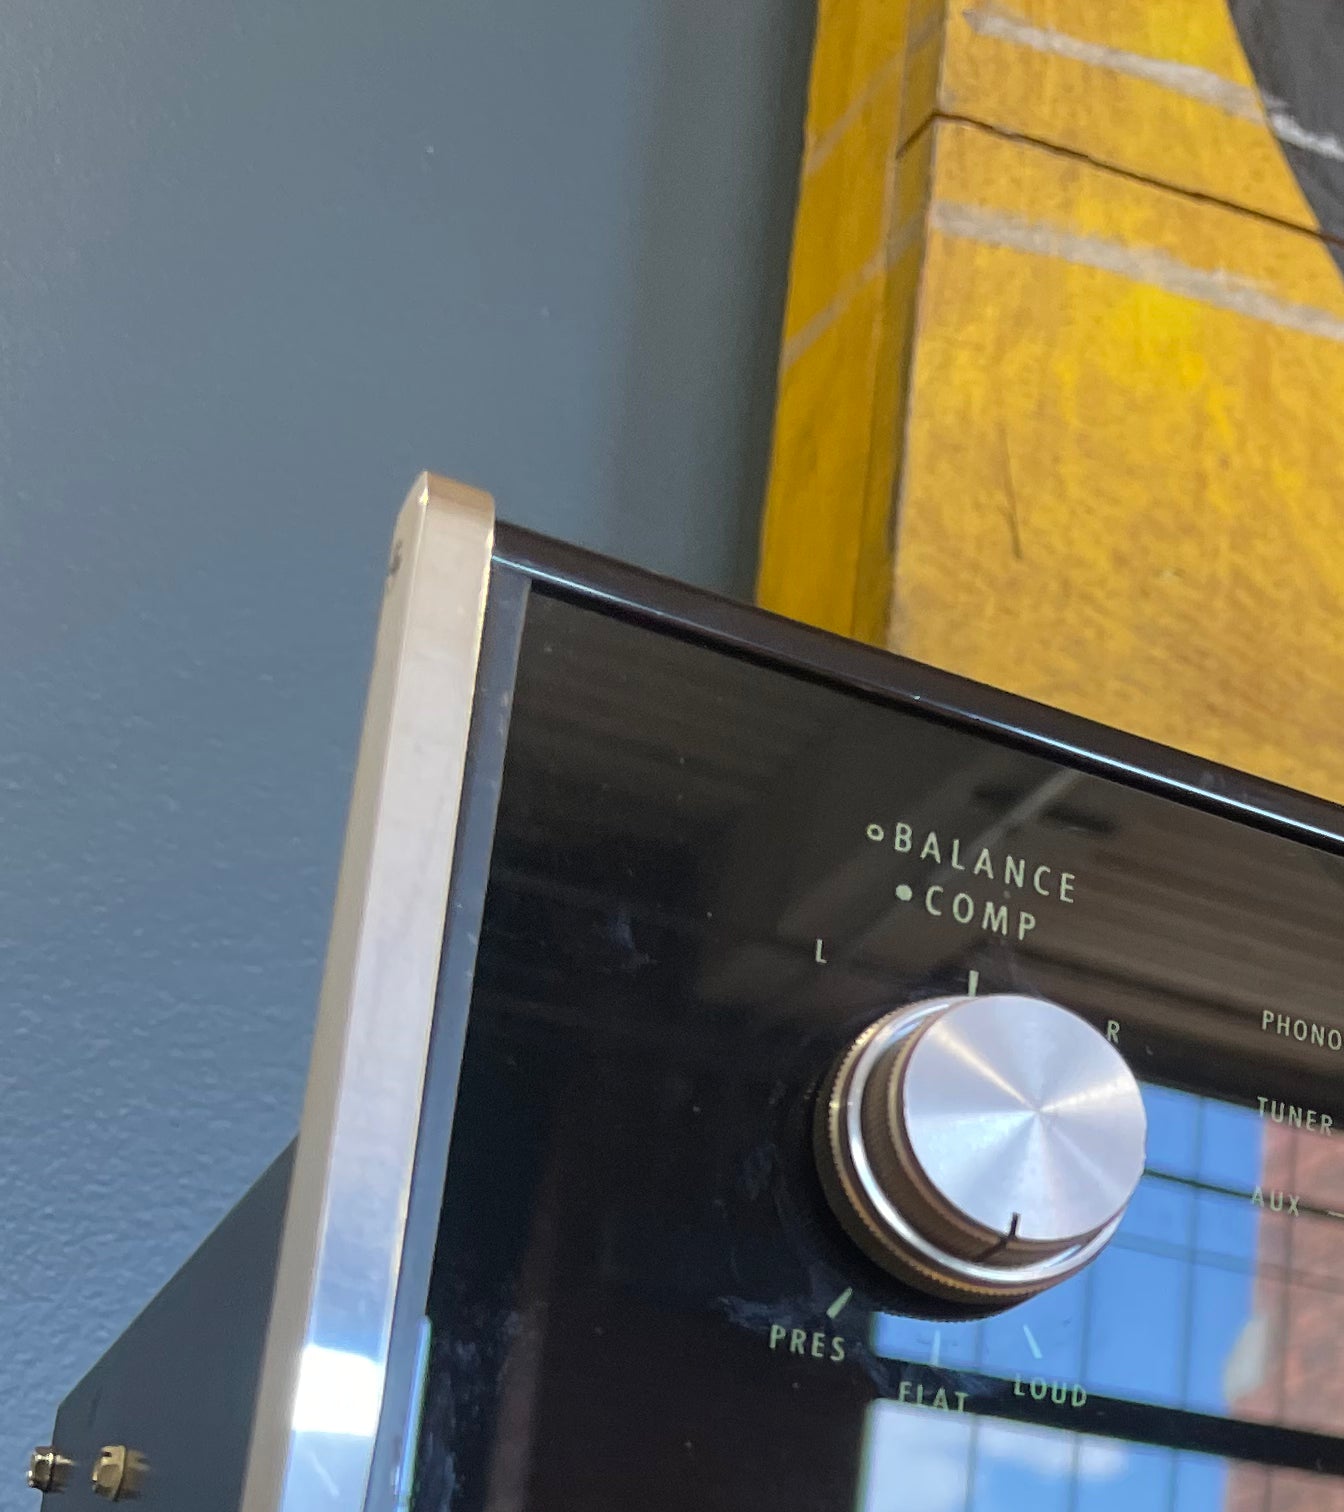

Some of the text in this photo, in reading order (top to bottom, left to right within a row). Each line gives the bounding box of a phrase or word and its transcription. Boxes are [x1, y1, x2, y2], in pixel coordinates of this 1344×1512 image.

[895, 823, 1075, 902] BALANCE
[926, 886, 1036, 941] COMP
[816, 939, 827, 963] L
[1107, 1020, 1120, 1044] R
[1262, 1011, 1342, 1052] PHONO
[1257, 1097, 1334, 1136] TUNER
[1251, 1186, 1301, 1217] AUX
[769, 1324, 846, 1362] PRES
[899, 1381, 970, 1412] FLAT
[1013, 1373, 1087, 1408] LOUD
